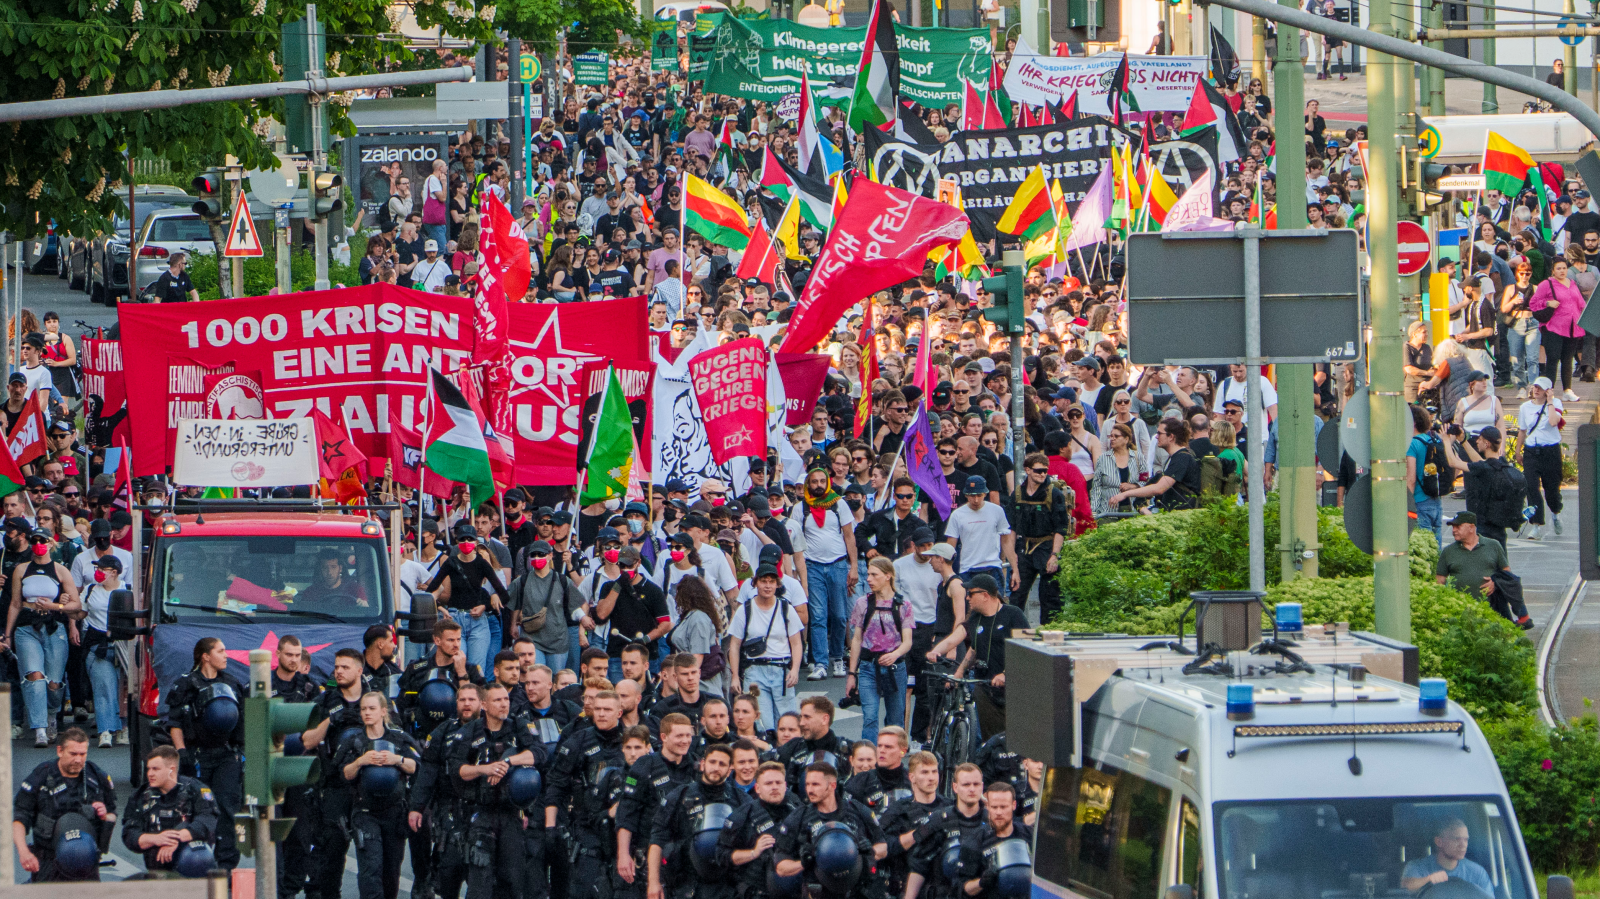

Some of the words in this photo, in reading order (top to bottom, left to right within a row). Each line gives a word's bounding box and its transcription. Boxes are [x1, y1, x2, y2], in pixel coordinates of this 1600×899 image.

[773, 32, 931, 54] Klimagerecgkeit
[816, 56, 934, 77] Klassampf
[1018, 63, 1044, 82] IHR
[739, 82, 796, 94] ENTEIGNEN!
[361, 145, 438, 162] zalando
[181, 312, 288, 349] 1000
[301, 302, 460, 340] KRISEN
[273, 343, 372, 380] EINE
[1326, 347, 1343, 356] 667
[692, 346, 765, 380] JUGEND
[695, 362, 765, 397] GEGEN
[714, 380, 753, 402] IHRE
